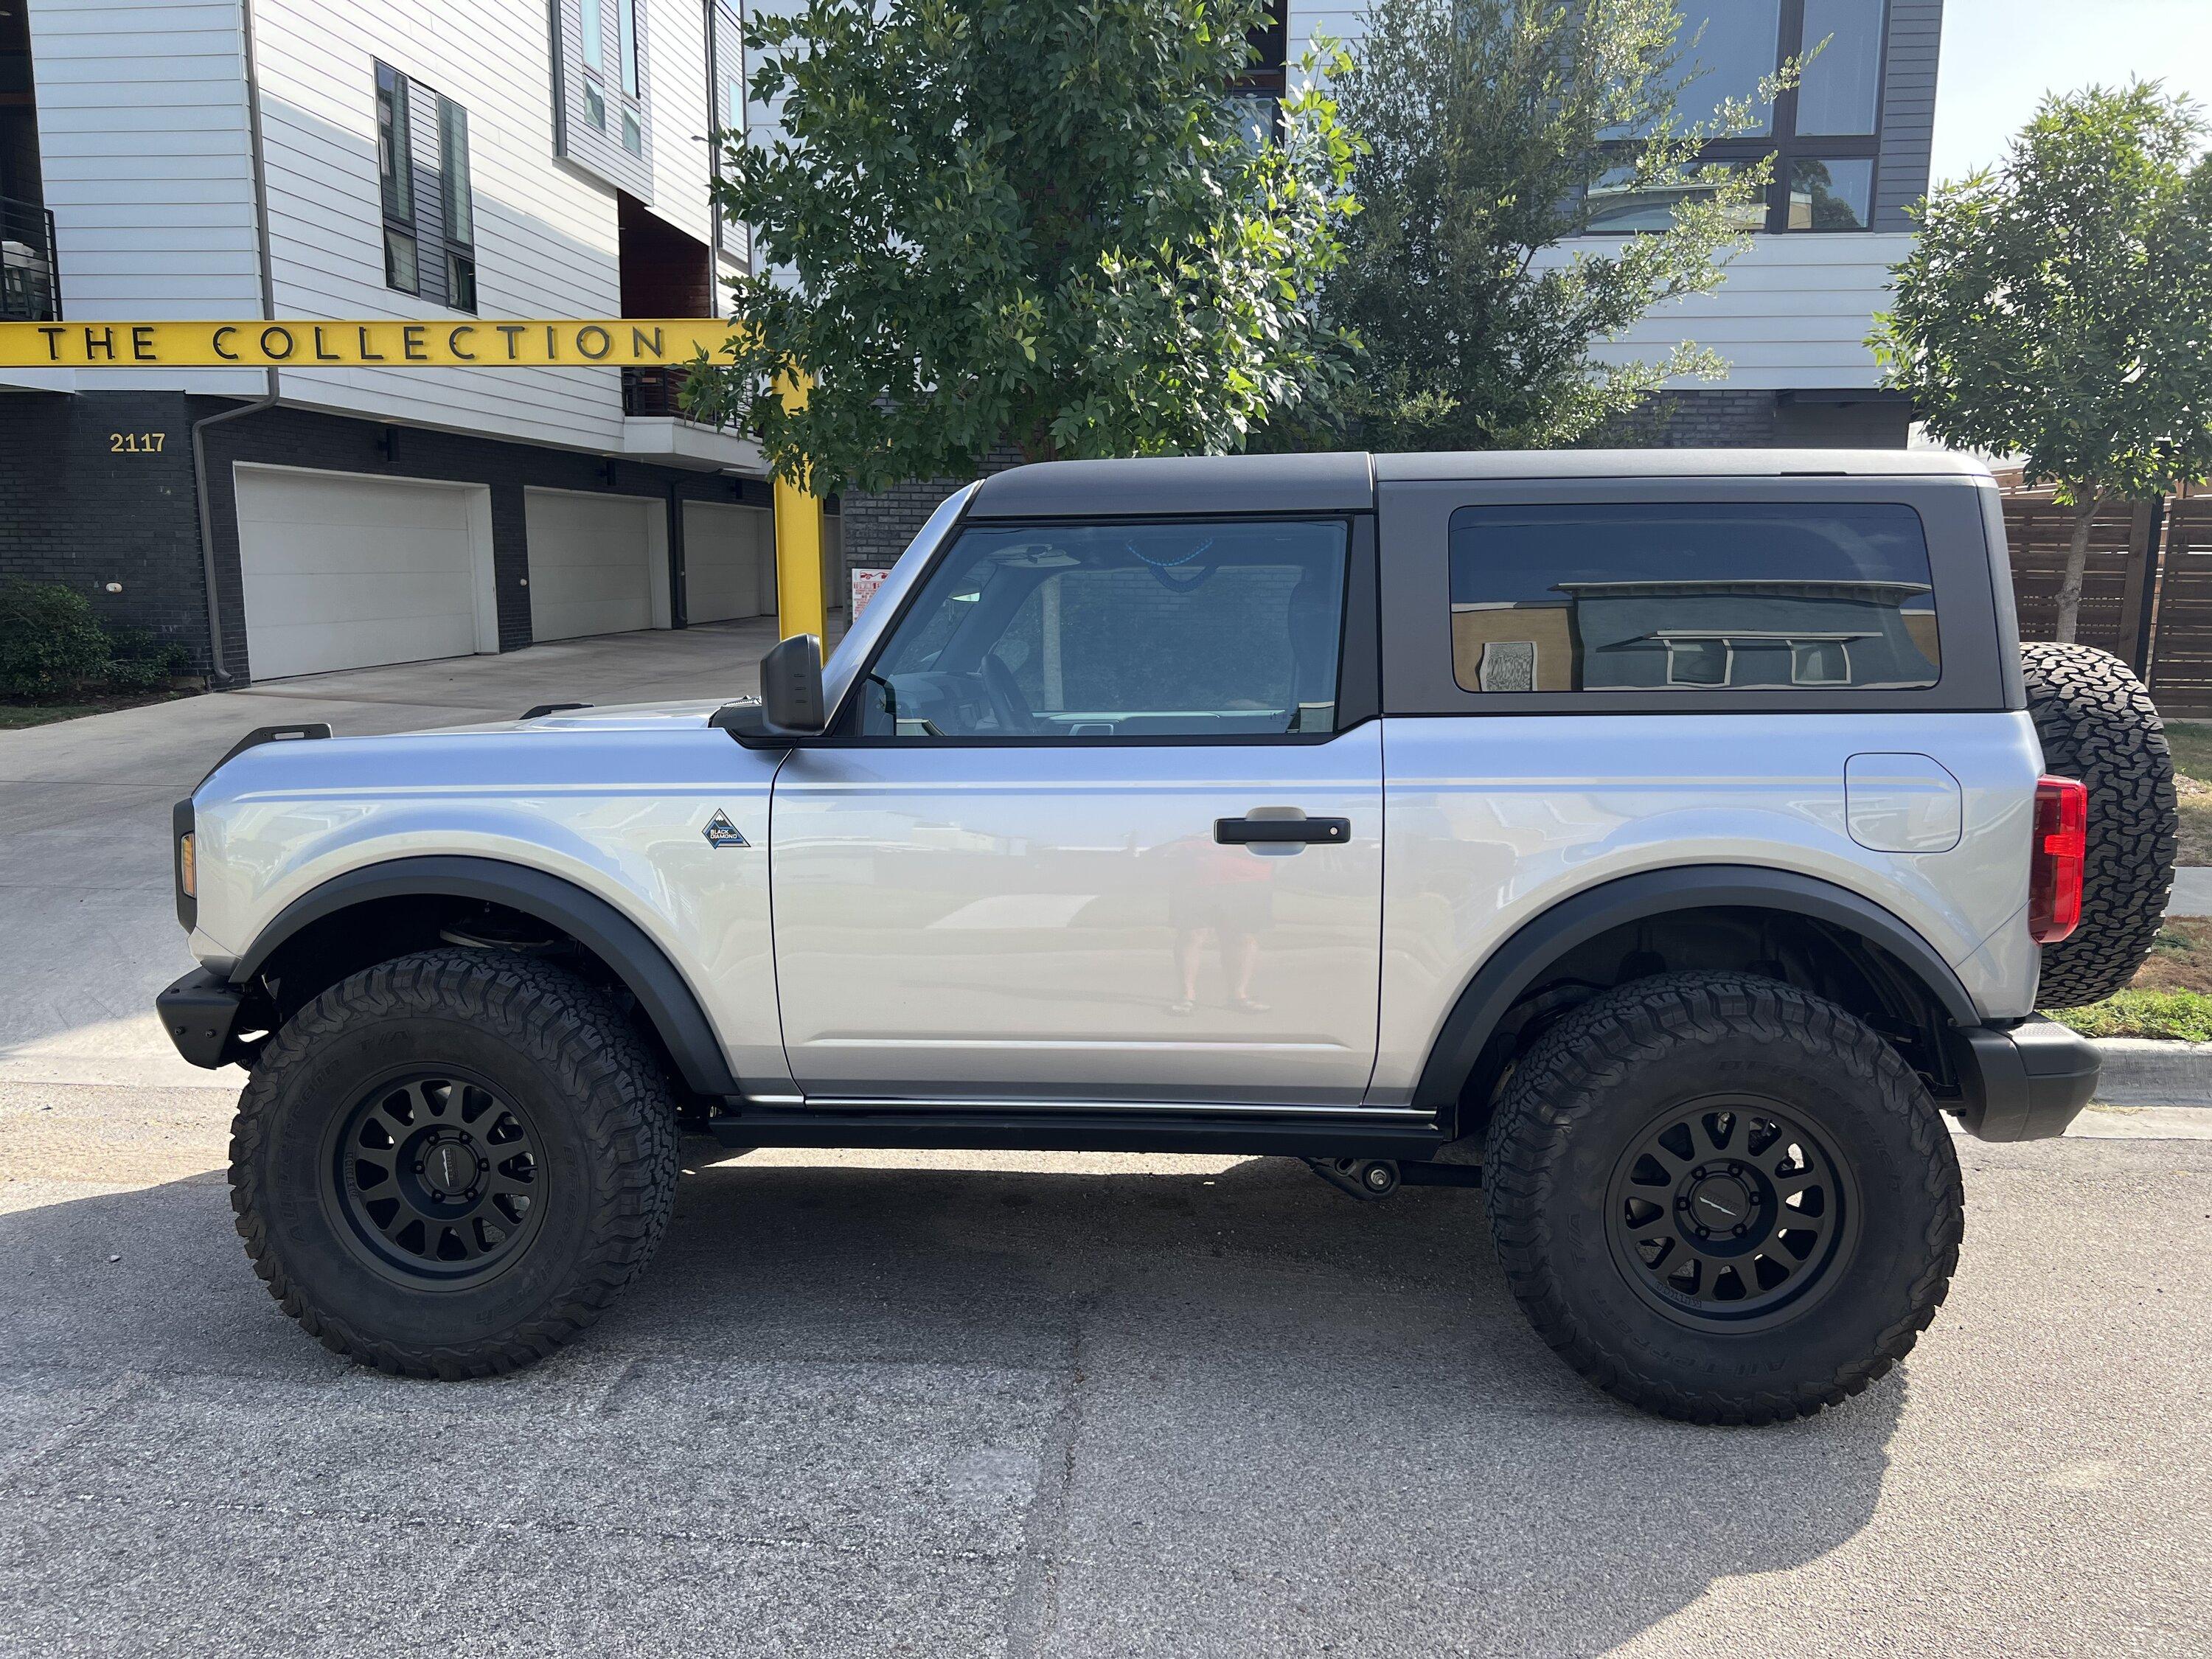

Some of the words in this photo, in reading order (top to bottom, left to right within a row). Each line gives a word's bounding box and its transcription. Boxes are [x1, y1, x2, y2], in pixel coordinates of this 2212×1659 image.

[38, 327, 157, 361] THE
[212, 325, 662, 361] COLLECTION
[109, 432, 166, 452] 2117
